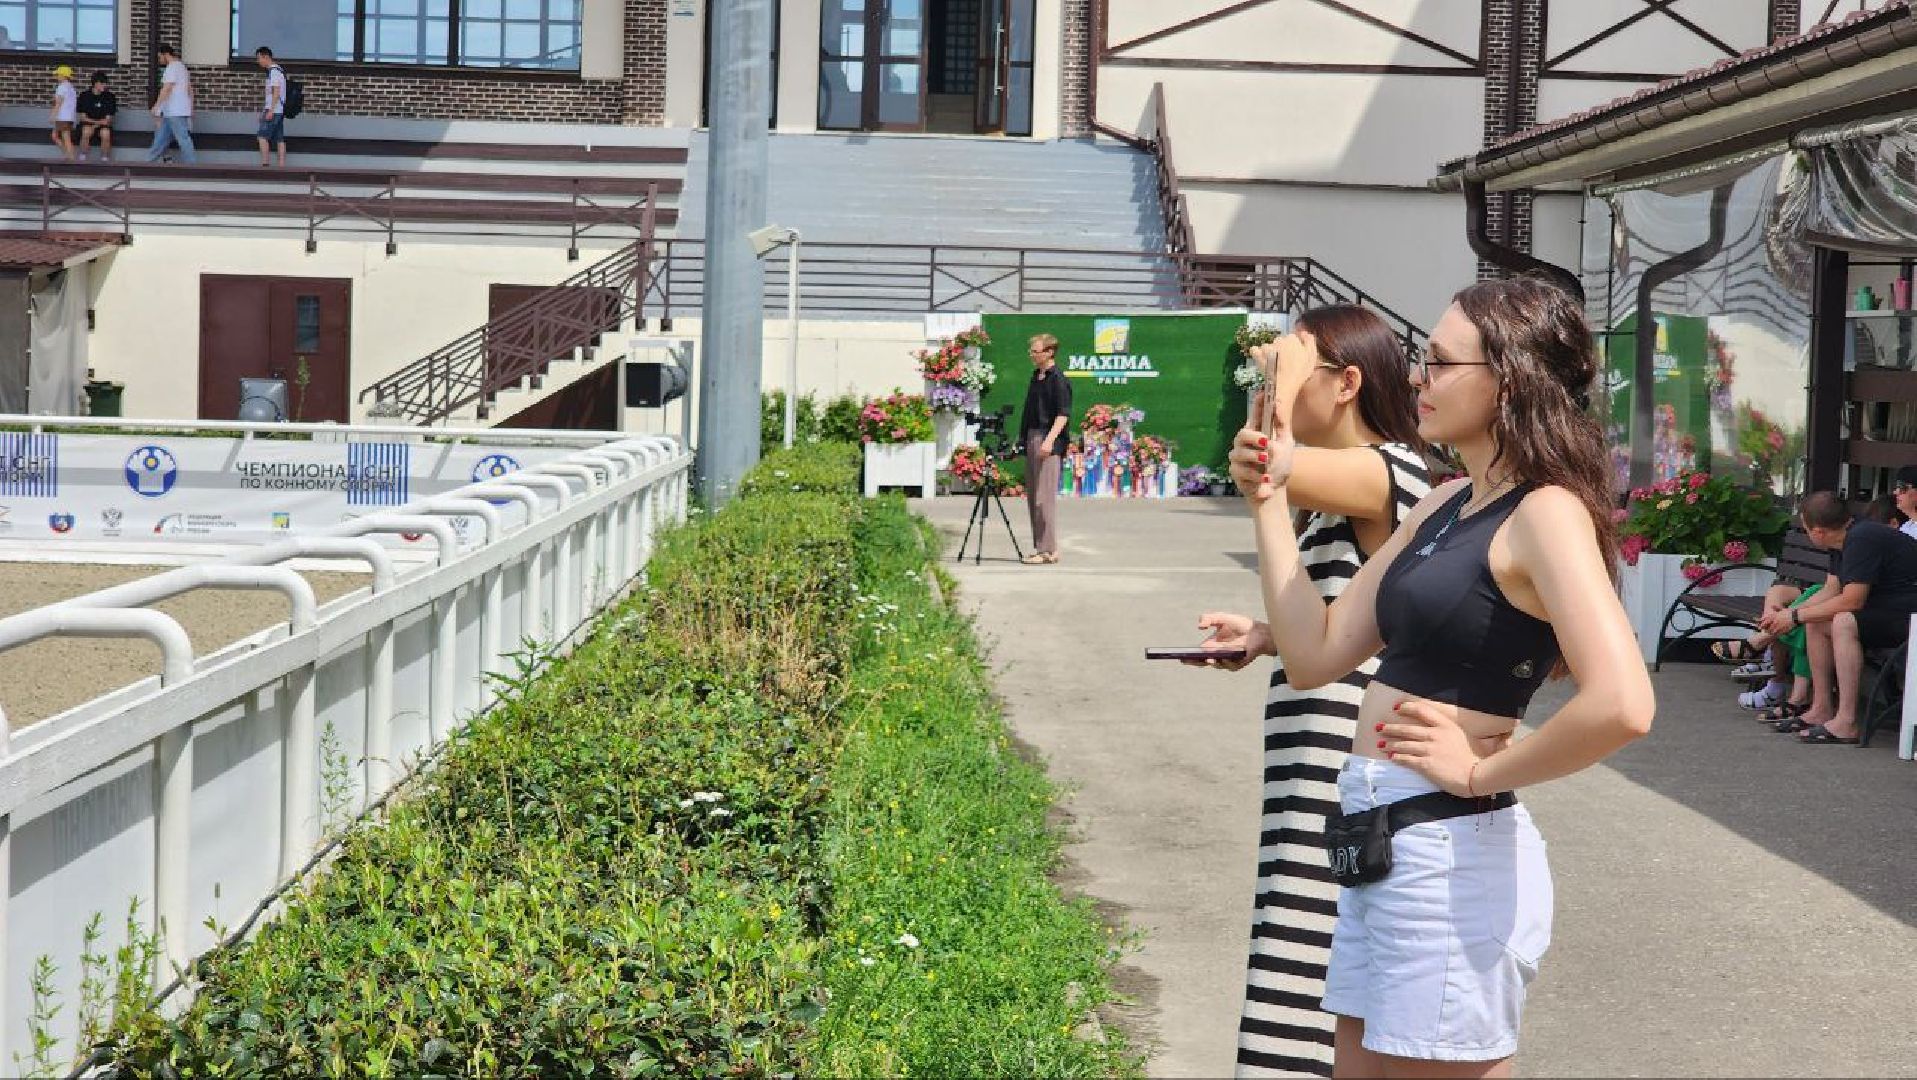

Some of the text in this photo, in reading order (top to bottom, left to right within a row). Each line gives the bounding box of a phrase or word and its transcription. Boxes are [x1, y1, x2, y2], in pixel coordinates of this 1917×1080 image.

[1068, 355, 1151, 370] MAXIMA
[235, 461, 402, 479] ЧЕМПИОНАТ СНГ
[240, 478, 396, 491] ПО КОННОМУ СПОРТУ
